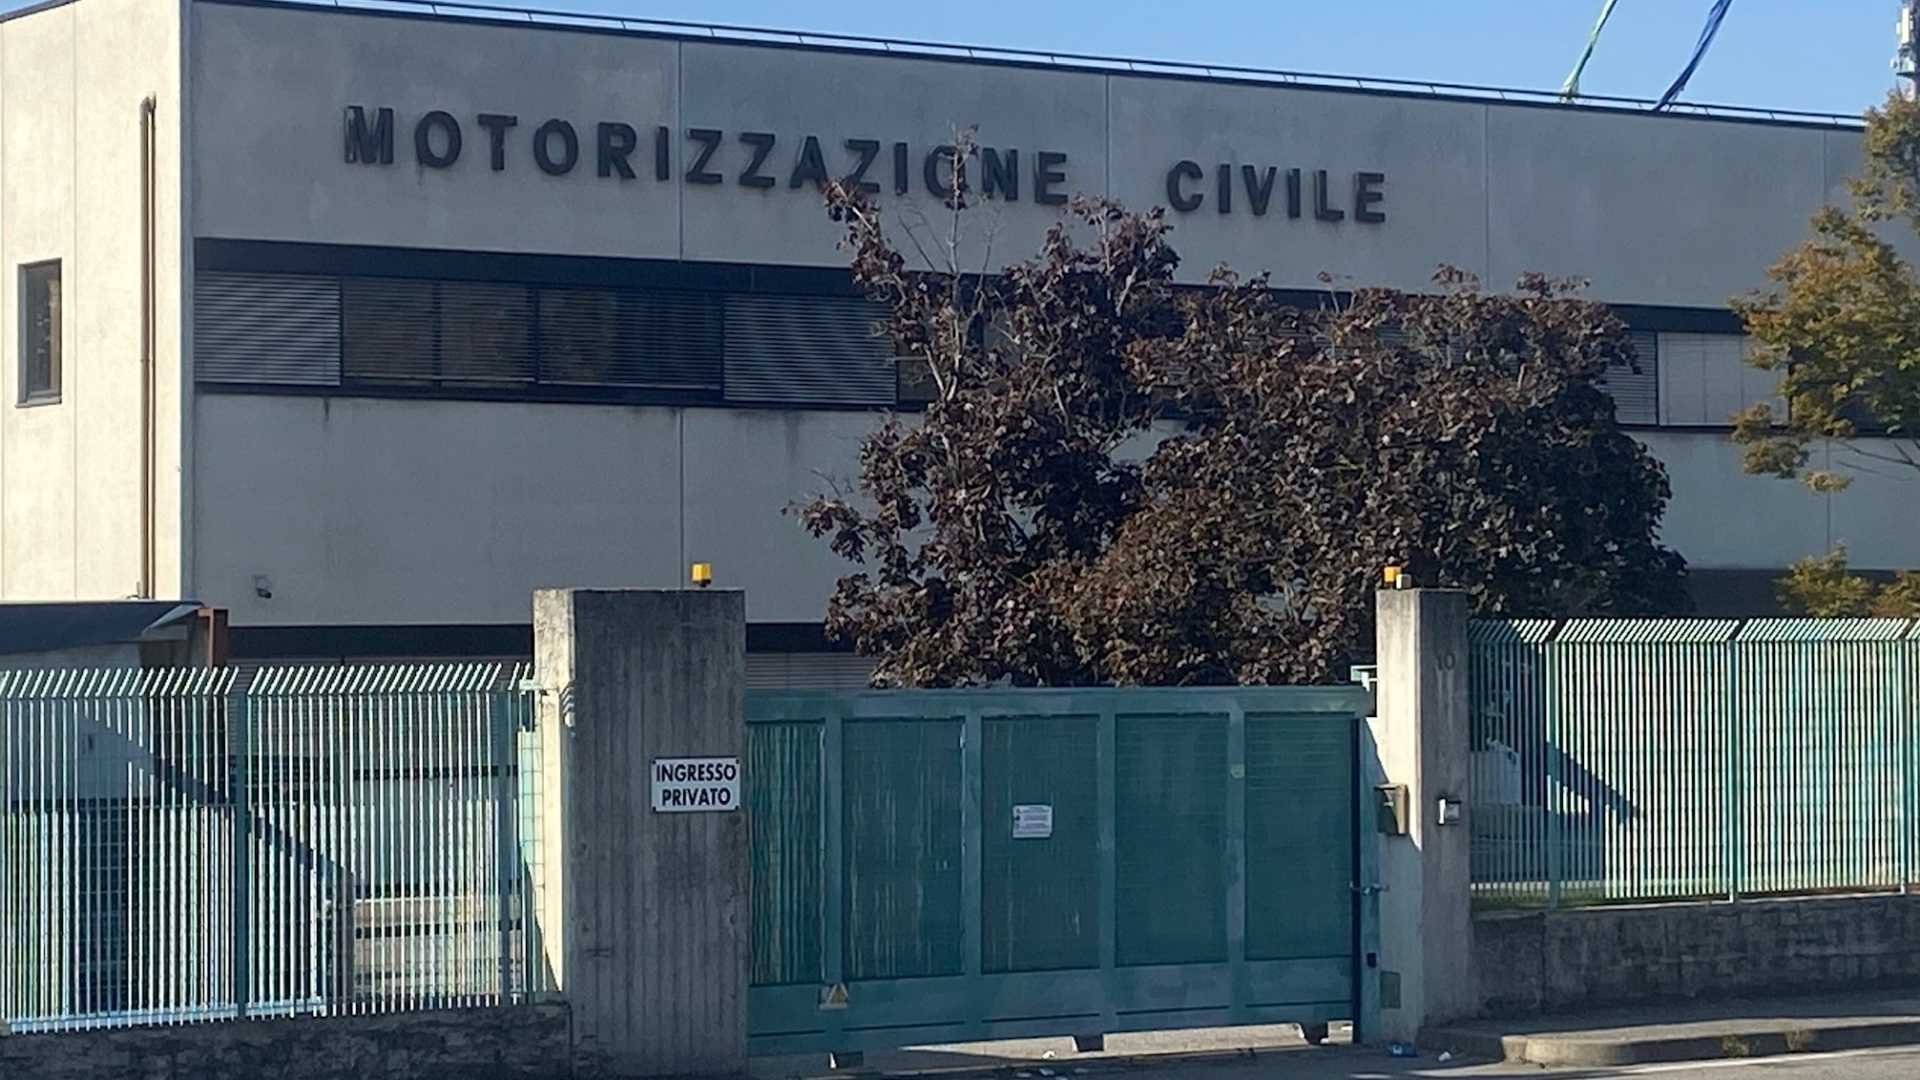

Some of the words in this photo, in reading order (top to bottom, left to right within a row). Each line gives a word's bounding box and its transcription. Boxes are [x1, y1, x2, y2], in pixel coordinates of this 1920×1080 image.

[344, 105, 1069, 205] MOTORIZZAZIONE
[1166, 160, 1386, 223] CIVILE
[656, 763, 737, 782] INGRESSO
[662, 787, 731, 806] PRIVATO
